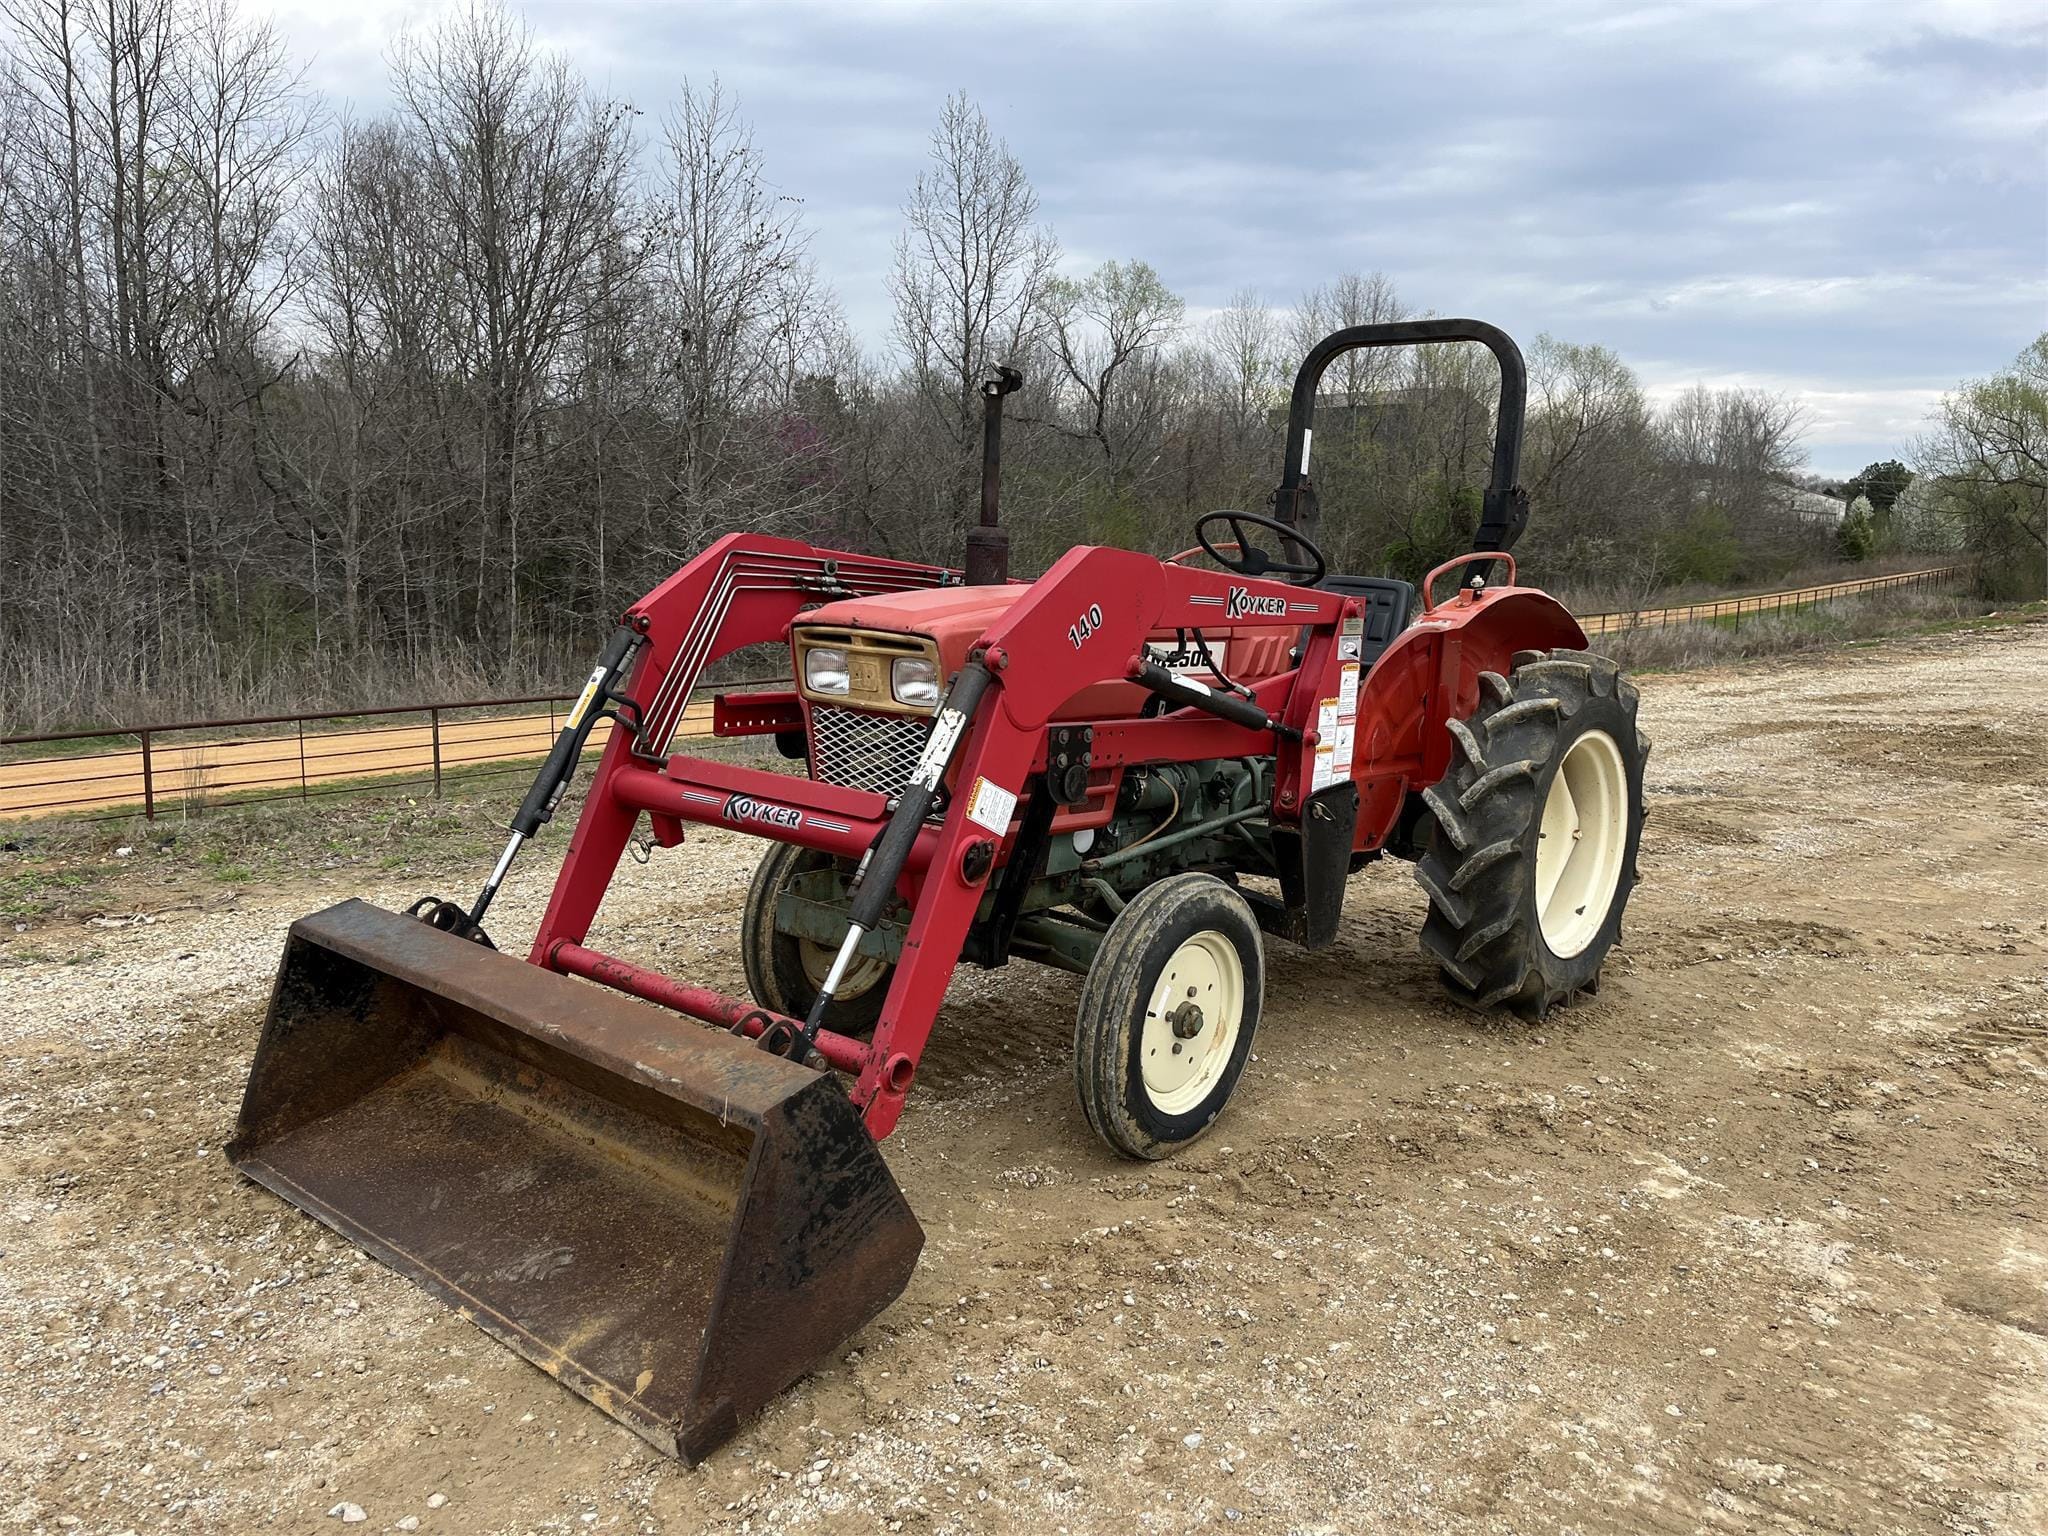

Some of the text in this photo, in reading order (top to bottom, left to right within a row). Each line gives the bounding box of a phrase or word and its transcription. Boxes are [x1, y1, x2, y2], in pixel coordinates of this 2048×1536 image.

[1226, 587, 1286, 619] KOYKER
[1068, 604, 1102, 649] 140
[723, 793, 802, 829] KOYKER
